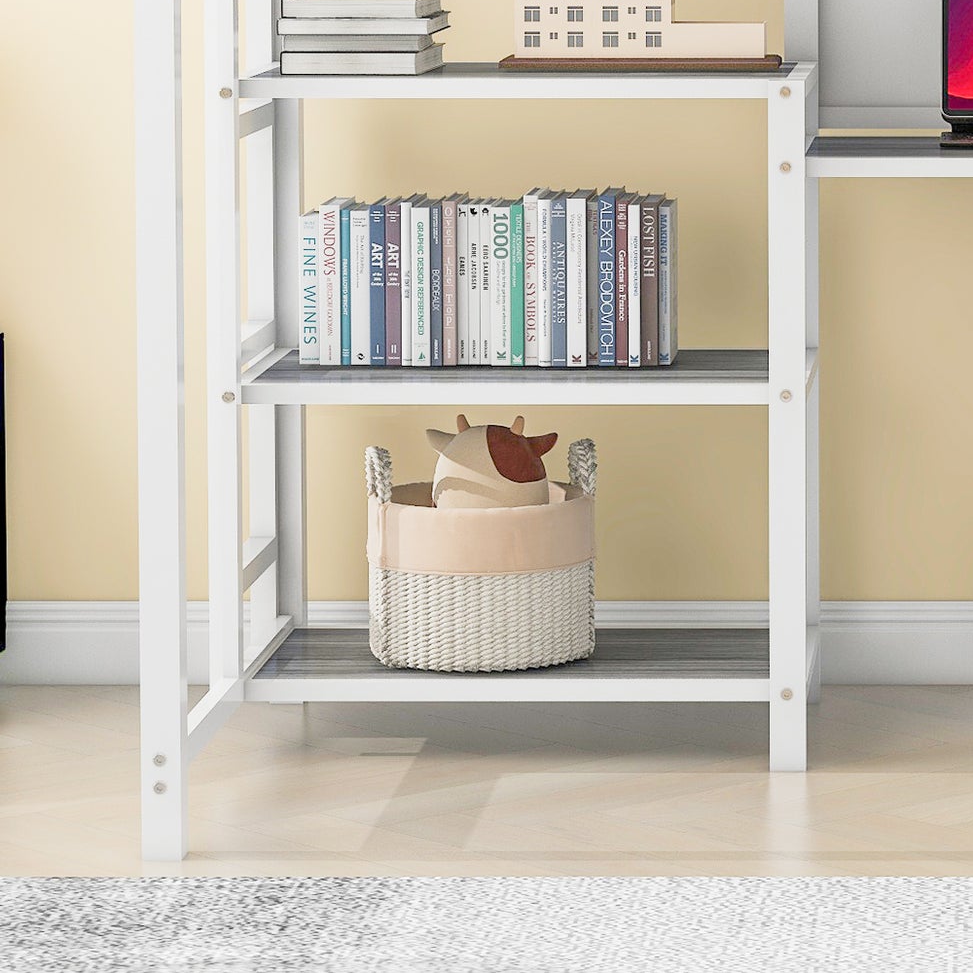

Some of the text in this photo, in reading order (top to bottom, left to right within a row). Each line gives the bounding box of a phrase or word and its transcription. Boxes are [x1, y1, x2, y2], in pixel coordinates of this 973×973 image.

[324, 211, 336, 276] WINDOWS
[493, 213, 509, 259] 1000
[526, 236, 536, 270] BOOK
[600, 200, 613, 257] ALEXEY
[643, 207, 655, 277] LOST FISH
[303, 237, 317, 277] FINE
[372, 243, 383, 268] ART
[388, 243, 400, 268] ART
[660, 256, 667, 266] IT
[432, 269, 440, 311] BORDEAUX
[556, 242, 565, 324] ANTIQUAIRES
[600, 261, 613, 355] BRODOVITCH
[303, 285, 317, 345] WINES
[526, 283, 536, 342] SYMBOLS
